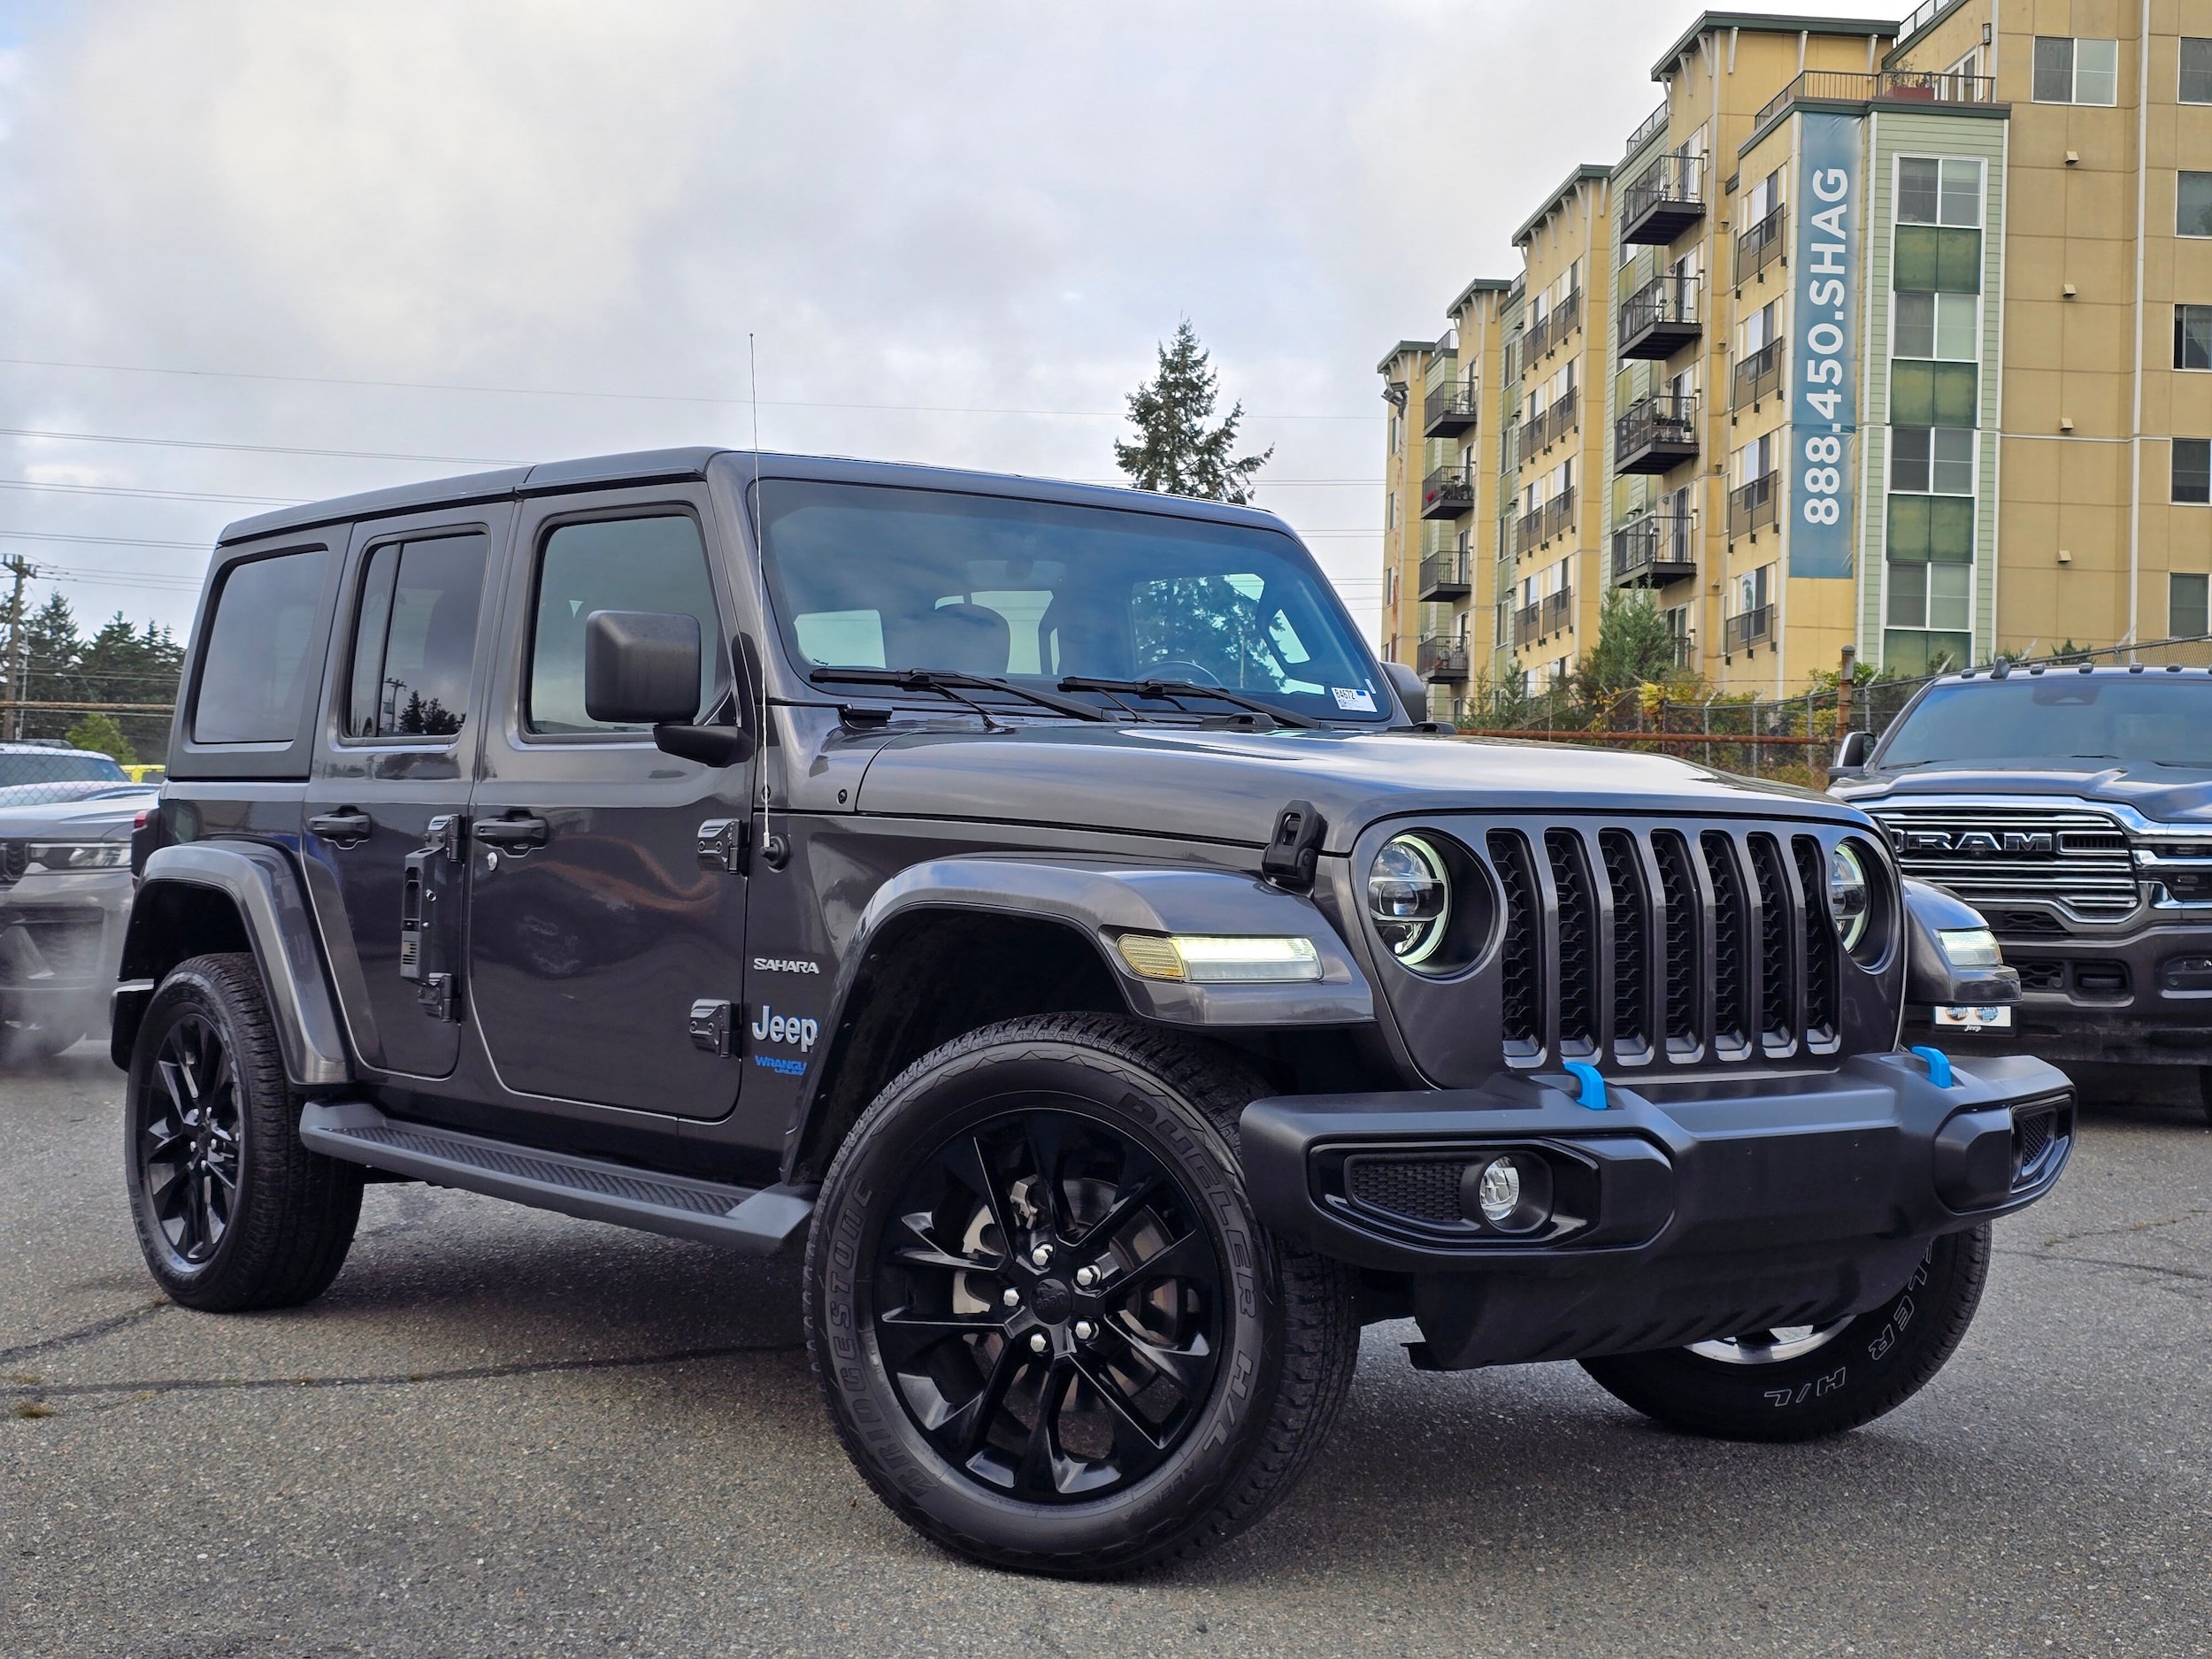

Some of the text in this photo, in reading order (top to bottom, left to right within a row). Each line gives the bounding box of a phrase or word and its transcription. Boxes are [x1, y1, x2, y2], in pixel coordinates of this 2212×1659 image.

[1803, 168, 1848, 526] 888.450.SHAG
[1906, 831, 2053, 852] RAM
[752, 1005, 818, 1053] Jeep
[753, 957, 820, 974] SAHARA
[829, 1177, 936, 1498] BRIDGESTONE
[1117, 1092, 1258, 1453] DUELER H/L
[1763, 1241, 1933, 1408] LER H/L
